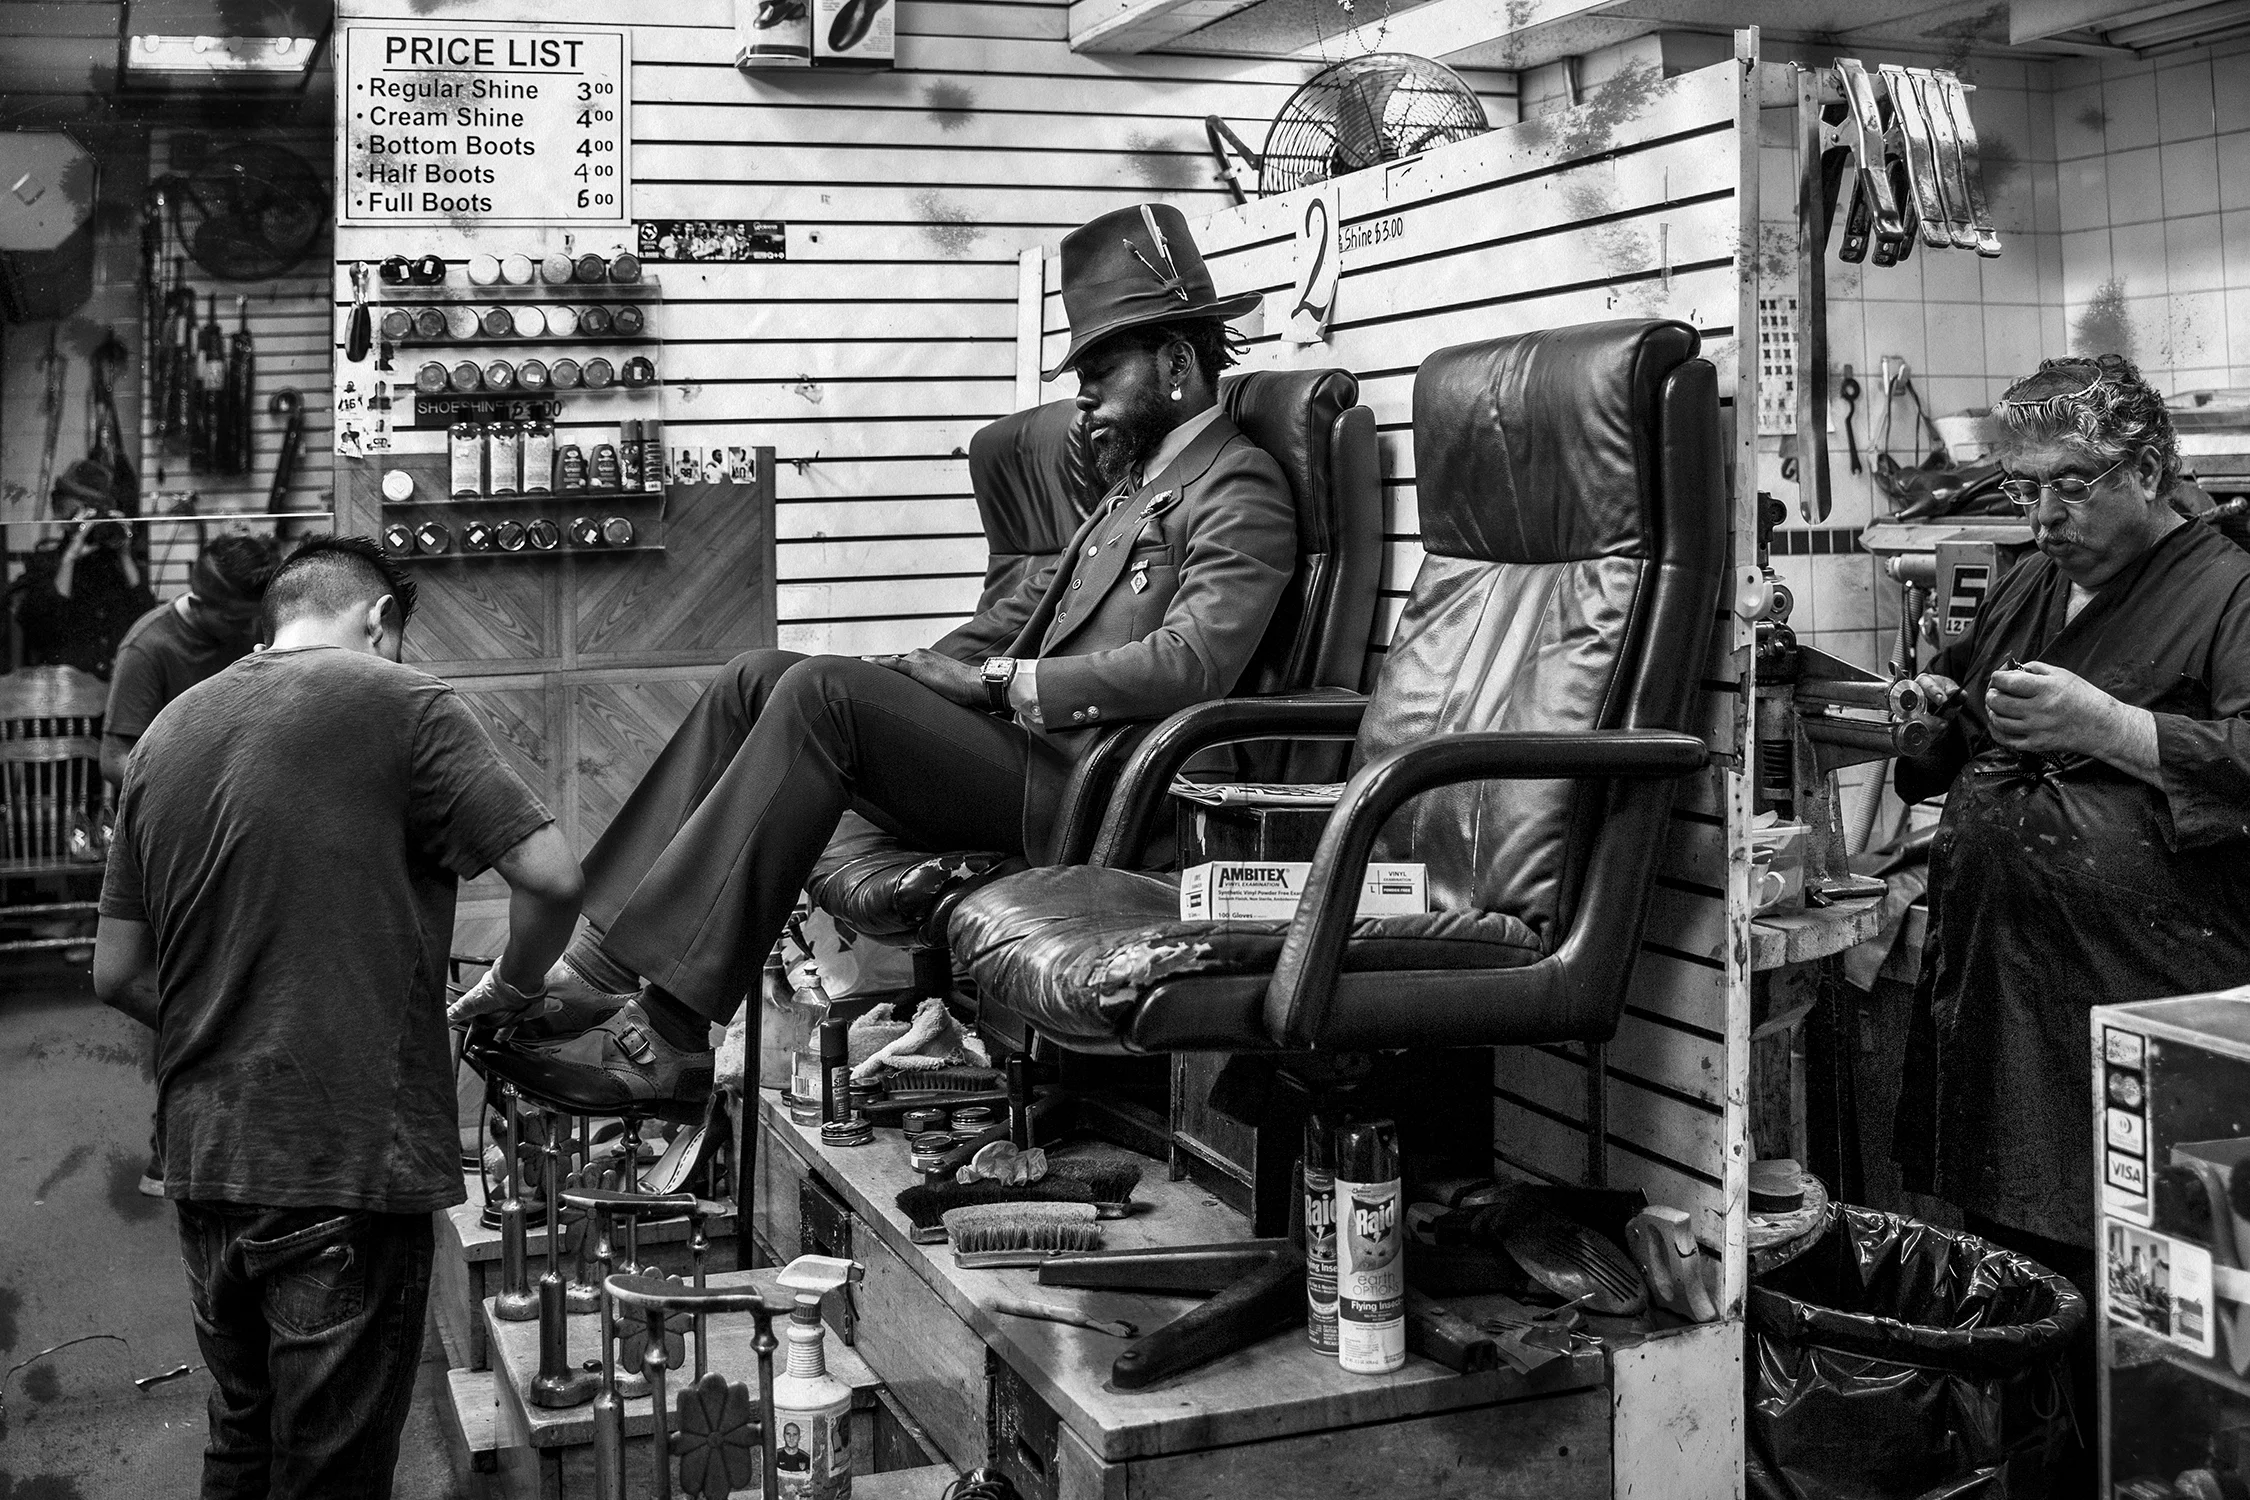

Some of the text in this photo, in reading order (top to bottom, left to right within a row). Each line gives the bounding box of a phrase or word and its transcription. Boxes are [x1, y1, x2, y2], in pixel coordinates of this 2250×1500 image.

[386, 36, 583, 67] PRICE LIST
[370, 77, 464, 101] Regular
[472, 79, 539, 99] Shine
[370, 106, 448, 126] Cream
[457, 107, 524, 127] Shine
[370, 135, 457, 155] Bottom
[467, 136, 535, 156] Boots
[369, 164, 417, 183] Half
[426, 164, 495, 184] Boots
[369, 193, 413, 212] Full
[423, 192, 492, 212] Boots
[1344, 226, 1373, 251] Shine
[1291, 198, 1328, 322] 2
[1218, 868, 1289, 888] AMBITEX
[1370, 885, 1376, 893] L
[2112, 1160, 2142, 1184] VISA
[1356, 1200, 1395, 1236] Raid
[1352, 1282, 1400, 1296] OPTIONS
[1357, 1271, 1395, 1286] earth
[1351, 1300, 1378, 1312] Flying
